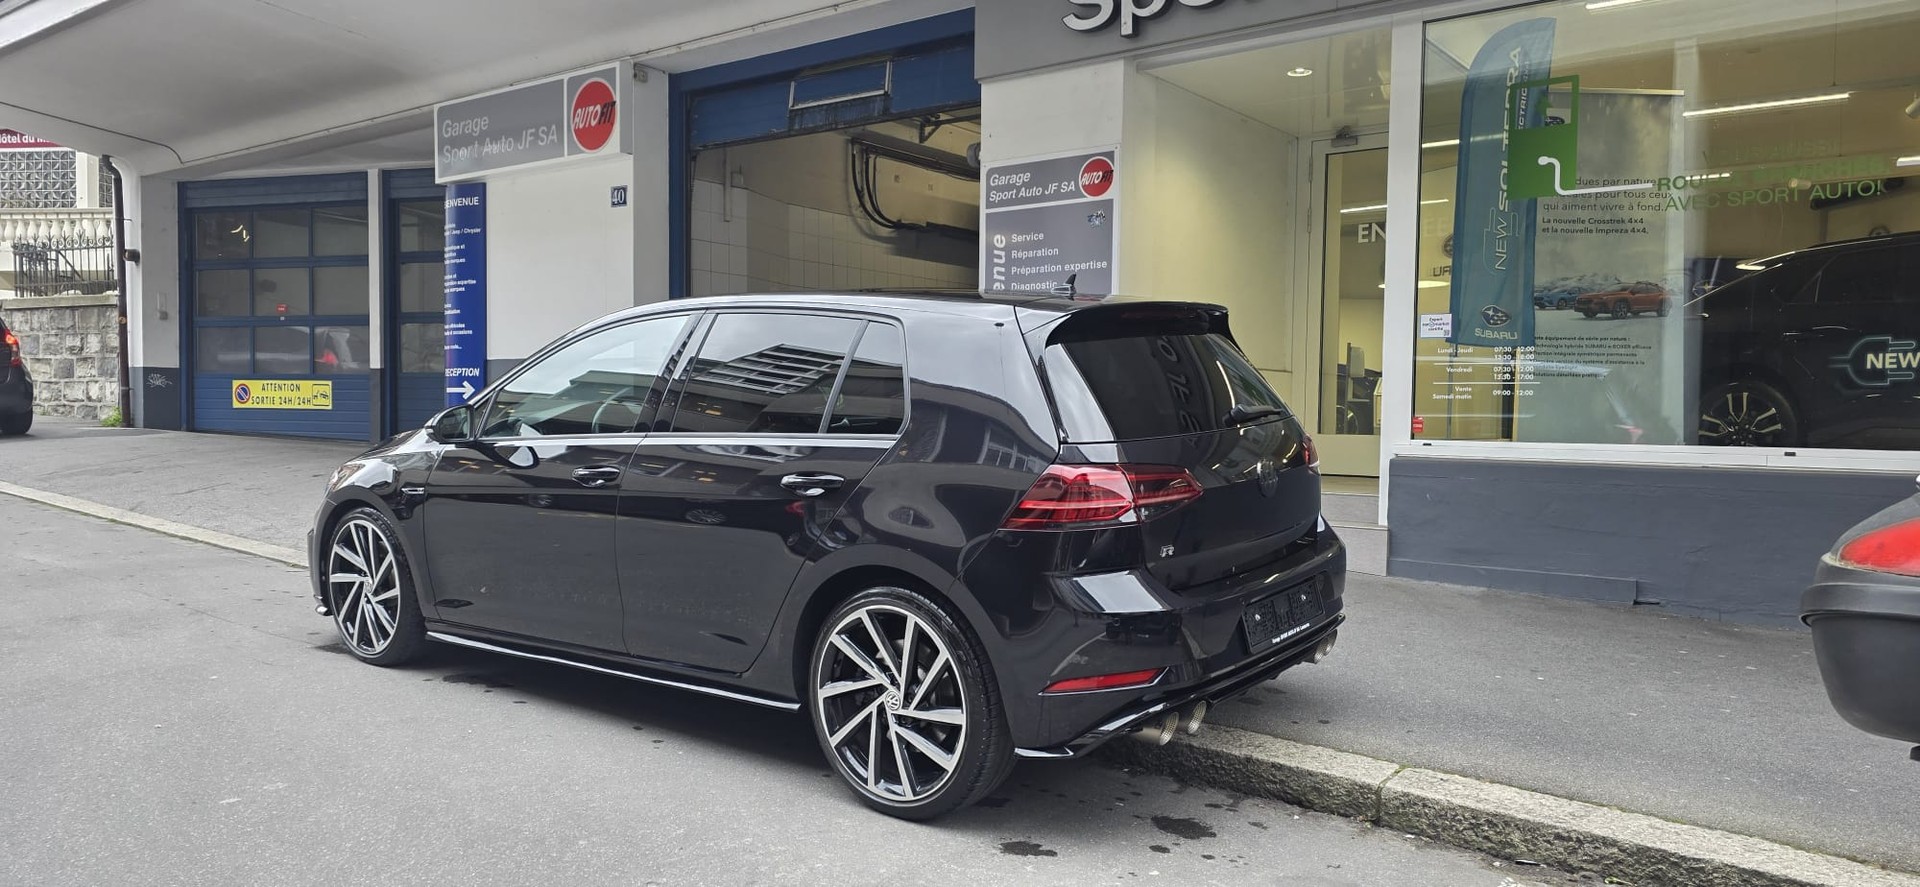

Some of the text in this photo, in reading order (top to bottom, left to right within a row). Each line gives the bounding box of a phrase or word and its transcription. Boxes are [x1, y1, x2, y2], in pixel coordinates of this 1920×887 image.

[573, 100, 617, 130] AUTOFIT
[442, 116, 489, 138] Garage
[442, 124, 558, 164] Sport Auto JF SA
[990, 172, 1031, 187] Garage
[1602, 179, 1620, 188] par
[612, 189, 626, 204] 40
[989, 181, 1075, 203] Sport Auto JF SA
[1595, 190, 1621, 199] pour
[1623, 189, 1646, 199] tous
[1648, 190, 1673, 199] ceux
[1664, 179, 1883, 212] AVEC SPORT AUTO!
[1543, 200, 1664, 212] qui aiment vivre à fond.
[1552, 217, 1585, 225] nouvelle
[1588, 217, 1626, 225] Crosstrek
[1011, 231, 1044, 243] Service
[1560, 226, 1593, 234] nouvelle
[1595, 226, 1629, 236] Impreza
[1495, 217, 1508, 270] NEW
[1011, 247, 1059, 261] Réparation
[993, 234, 1006, 291] enue
[1011, 260, 1108, 276] Préparation expertise
[1474, 328, 1518, 340] SUBARU
[1866, 352, 1920, 369] NEW
[261, 383, 301, 392] ATTENTION
[251, 396, 312, 406] SORTIE 24H/24H
